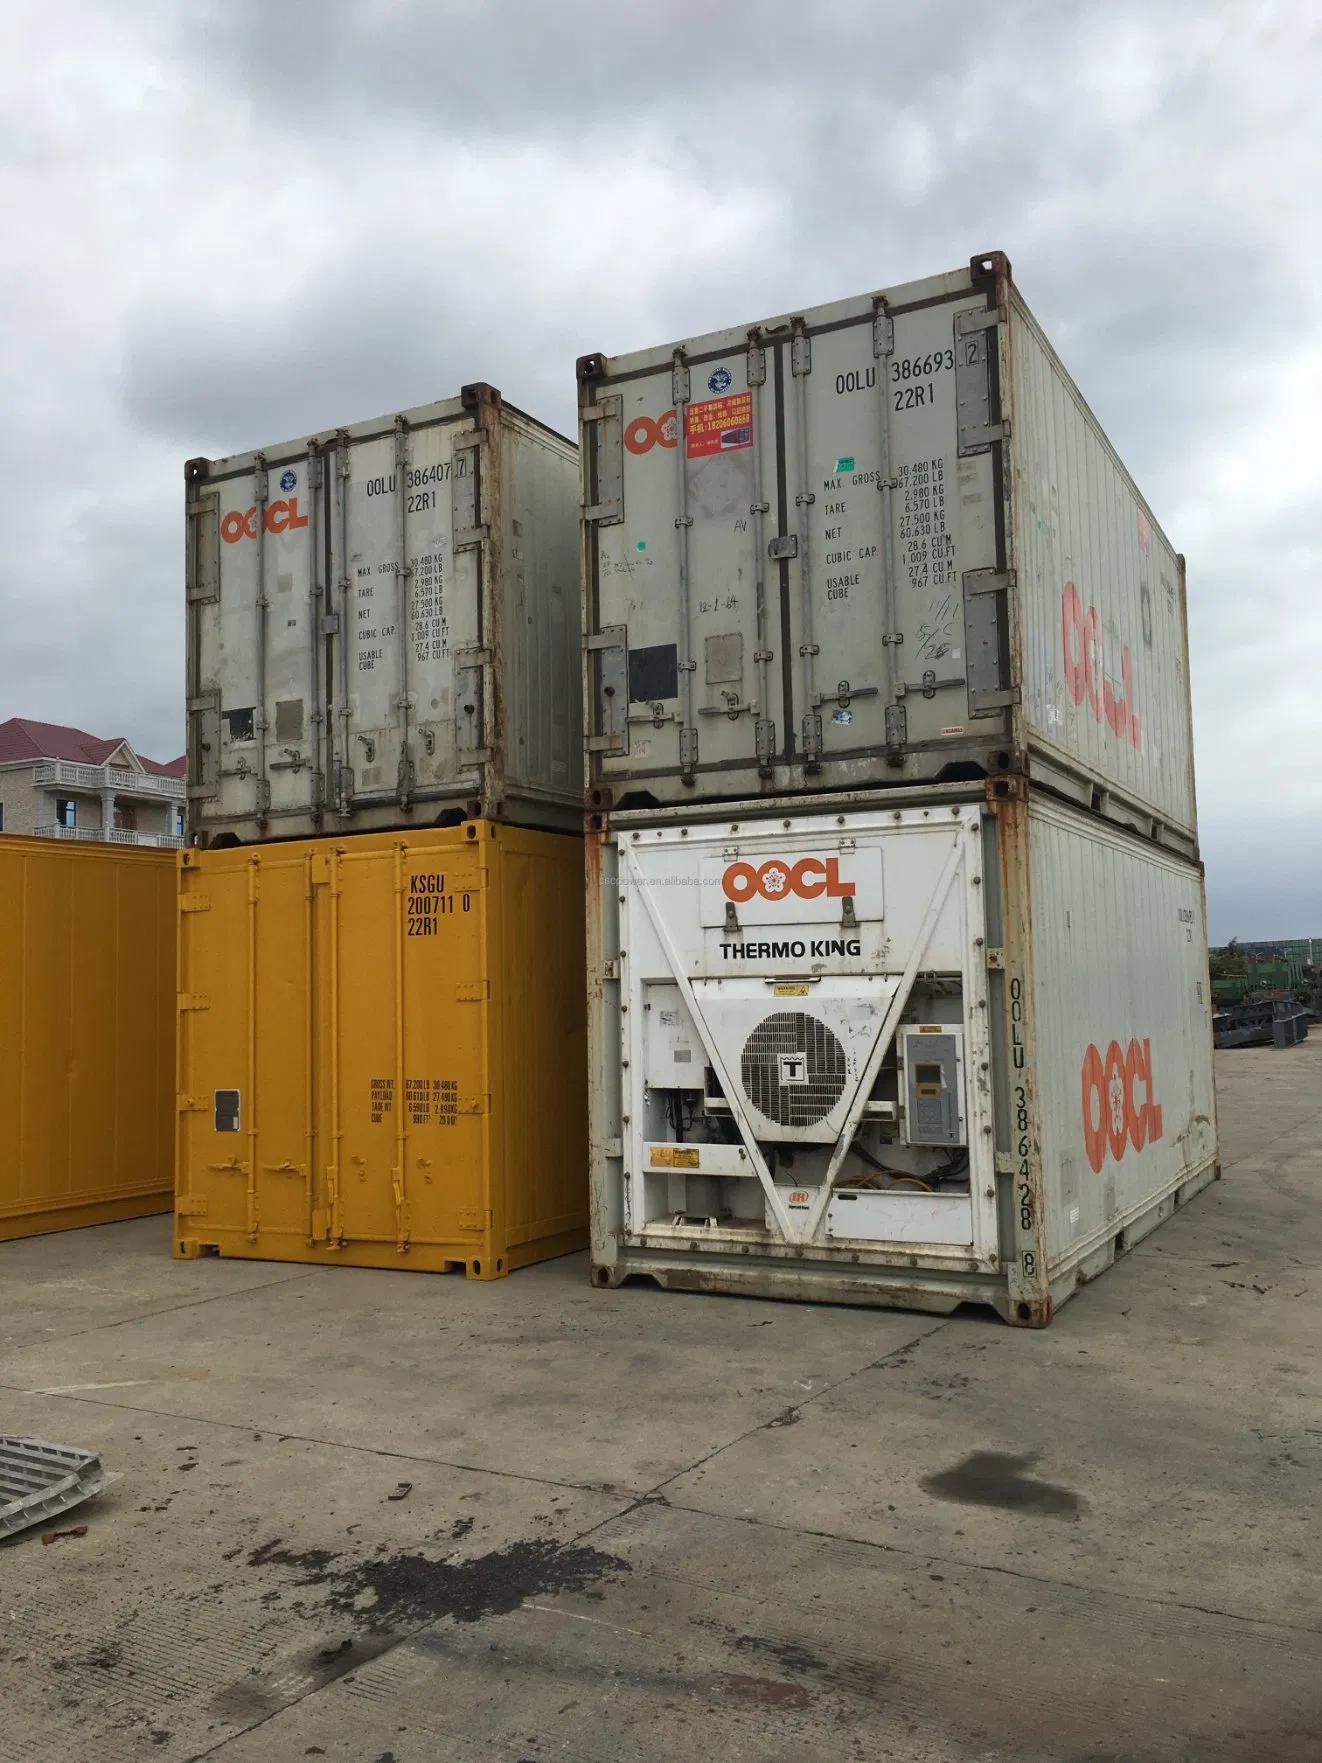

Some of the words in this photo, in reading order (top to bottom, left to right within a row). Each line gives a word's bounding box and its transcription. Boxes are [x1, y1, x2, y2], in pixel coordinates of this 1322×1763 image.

[891, 350, 954, 382] 386693
[966, 342, 978, 365] 2
[894, 383, 934, 411] 22R1
[407, 463, 451, 488] 386407
[458, 459, 465, 477] 7
[852, 471, 881, 486] GROSS
[898, 461, 929, 477] 30.480
[931, 458, 943, 471] KG
[898, 474, 929, 489] 67.200
[932, 470, 944, 482] LB
[905, 487, 930, 501] 2.980
[932, 484, 944, 496] KG
[408, 491, 436, 513] 22R1
[825, 502, 846, 516] TARE
[905, 500, 930, 513] 6.570
[933, 496, 944, 508] LB
[221, 497, 308, 544] OOCL
[900, 512, 930, 528] 27.500
[933, 510, 945, 522] KG
[825, 527, 842, 540] NET
[900, 525, 931, 539] 60.630
[934, 521, 946, 534] LB
[907, 539, 927, 552] 28.6
[378, 561, 399, 574] GROSS
[434, 553, 443, 563] KG
[826, 551, 852, 565] CUBIC
[902, 550, 928, 565] 1.009
[434, 563, 443, 574] LB
[908, 563, 928, 578] 27.4
[434, 574, 443, 585] KG
[827, 574, 860, 589] USABLE
[912, 576, 929, 589] 967
[358, 587, 374, 599] TARE
[434, 585, 443, 595] LB
[434, 596, 443, 606] KG
[827, 587, 849, 601] CUBE
[358, 609, 370, 619] NET
[434, 606, 443, 616] LB
[358, 629, 377, 641] CUBIC
[358, 649, 383, 661] USABLE
[417, 651, 429, 662] 967
[358, 660, 375, 671] CUBE
[411, 874, 445, 894] KSGU
[722, 857, 856, 903] OOCL
[408, 895, 453, 915] 200711
[408, 917, 437, 936] 22R1
[719, 941, 805, 960] THERMO
[811, 939, 861, 957] KING
[371, 1079, 386, 1089] GROSS
[371, 1090, 393, 1101] PAYLOAD
[1081, 1037, 1163, 1174] OOCL
[371, 1113, 383, 1123] CUBE
[1014, 1086, 1032, 1231] 386428
[1024, 1252, 1035, 1276] 8
